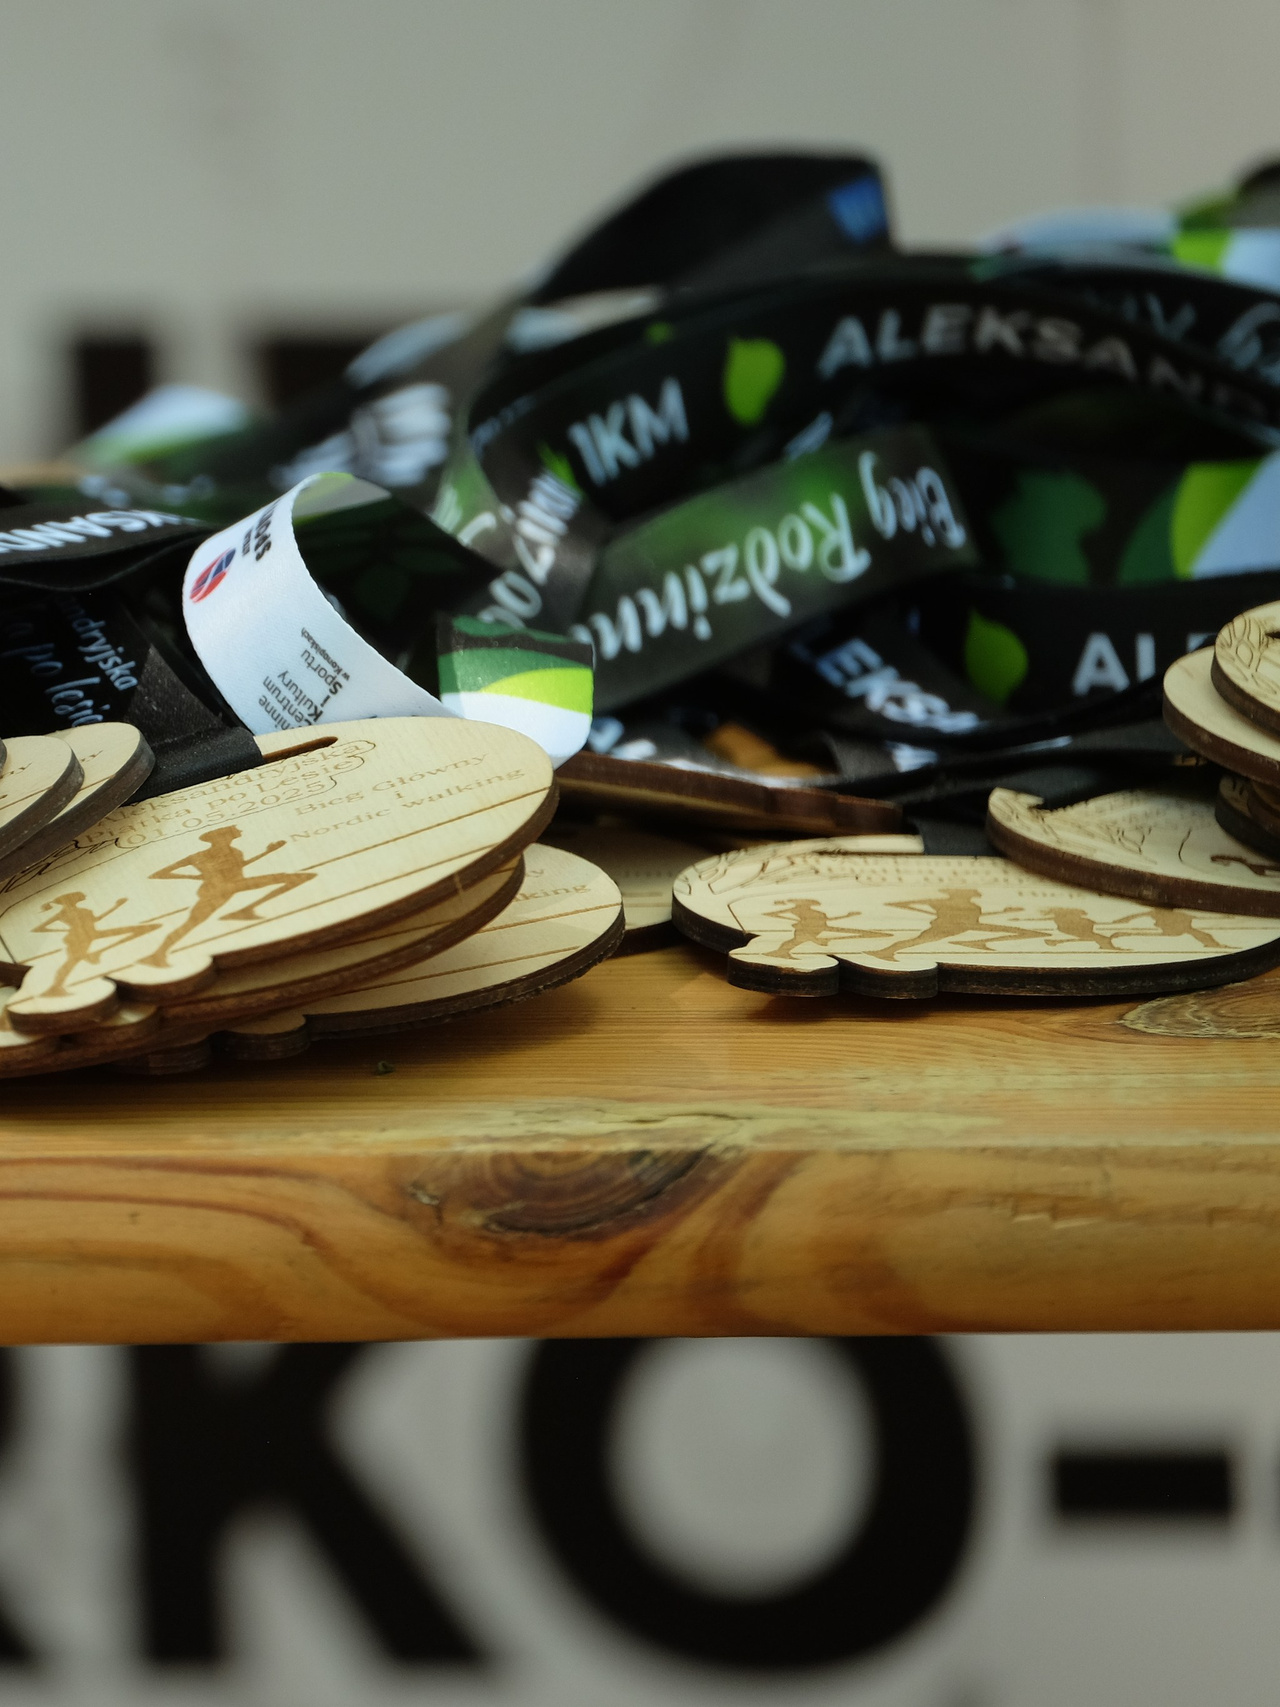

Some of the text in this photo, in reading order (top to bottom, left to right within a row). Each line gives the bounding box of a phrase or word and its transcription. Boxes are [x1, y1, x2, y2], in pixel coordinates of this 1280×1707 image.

[277, 669, 324, 724] Kultury
[299, 648, 343, 696] Sportu
[206, 791, 248, 810] po
[256, 759, 356, 793] Lesie
[289, 768, 526, 843] Nordic walking
[294, 790, 365, 816] Bieg
[126, 779, 326, 846] 01.05.2025
